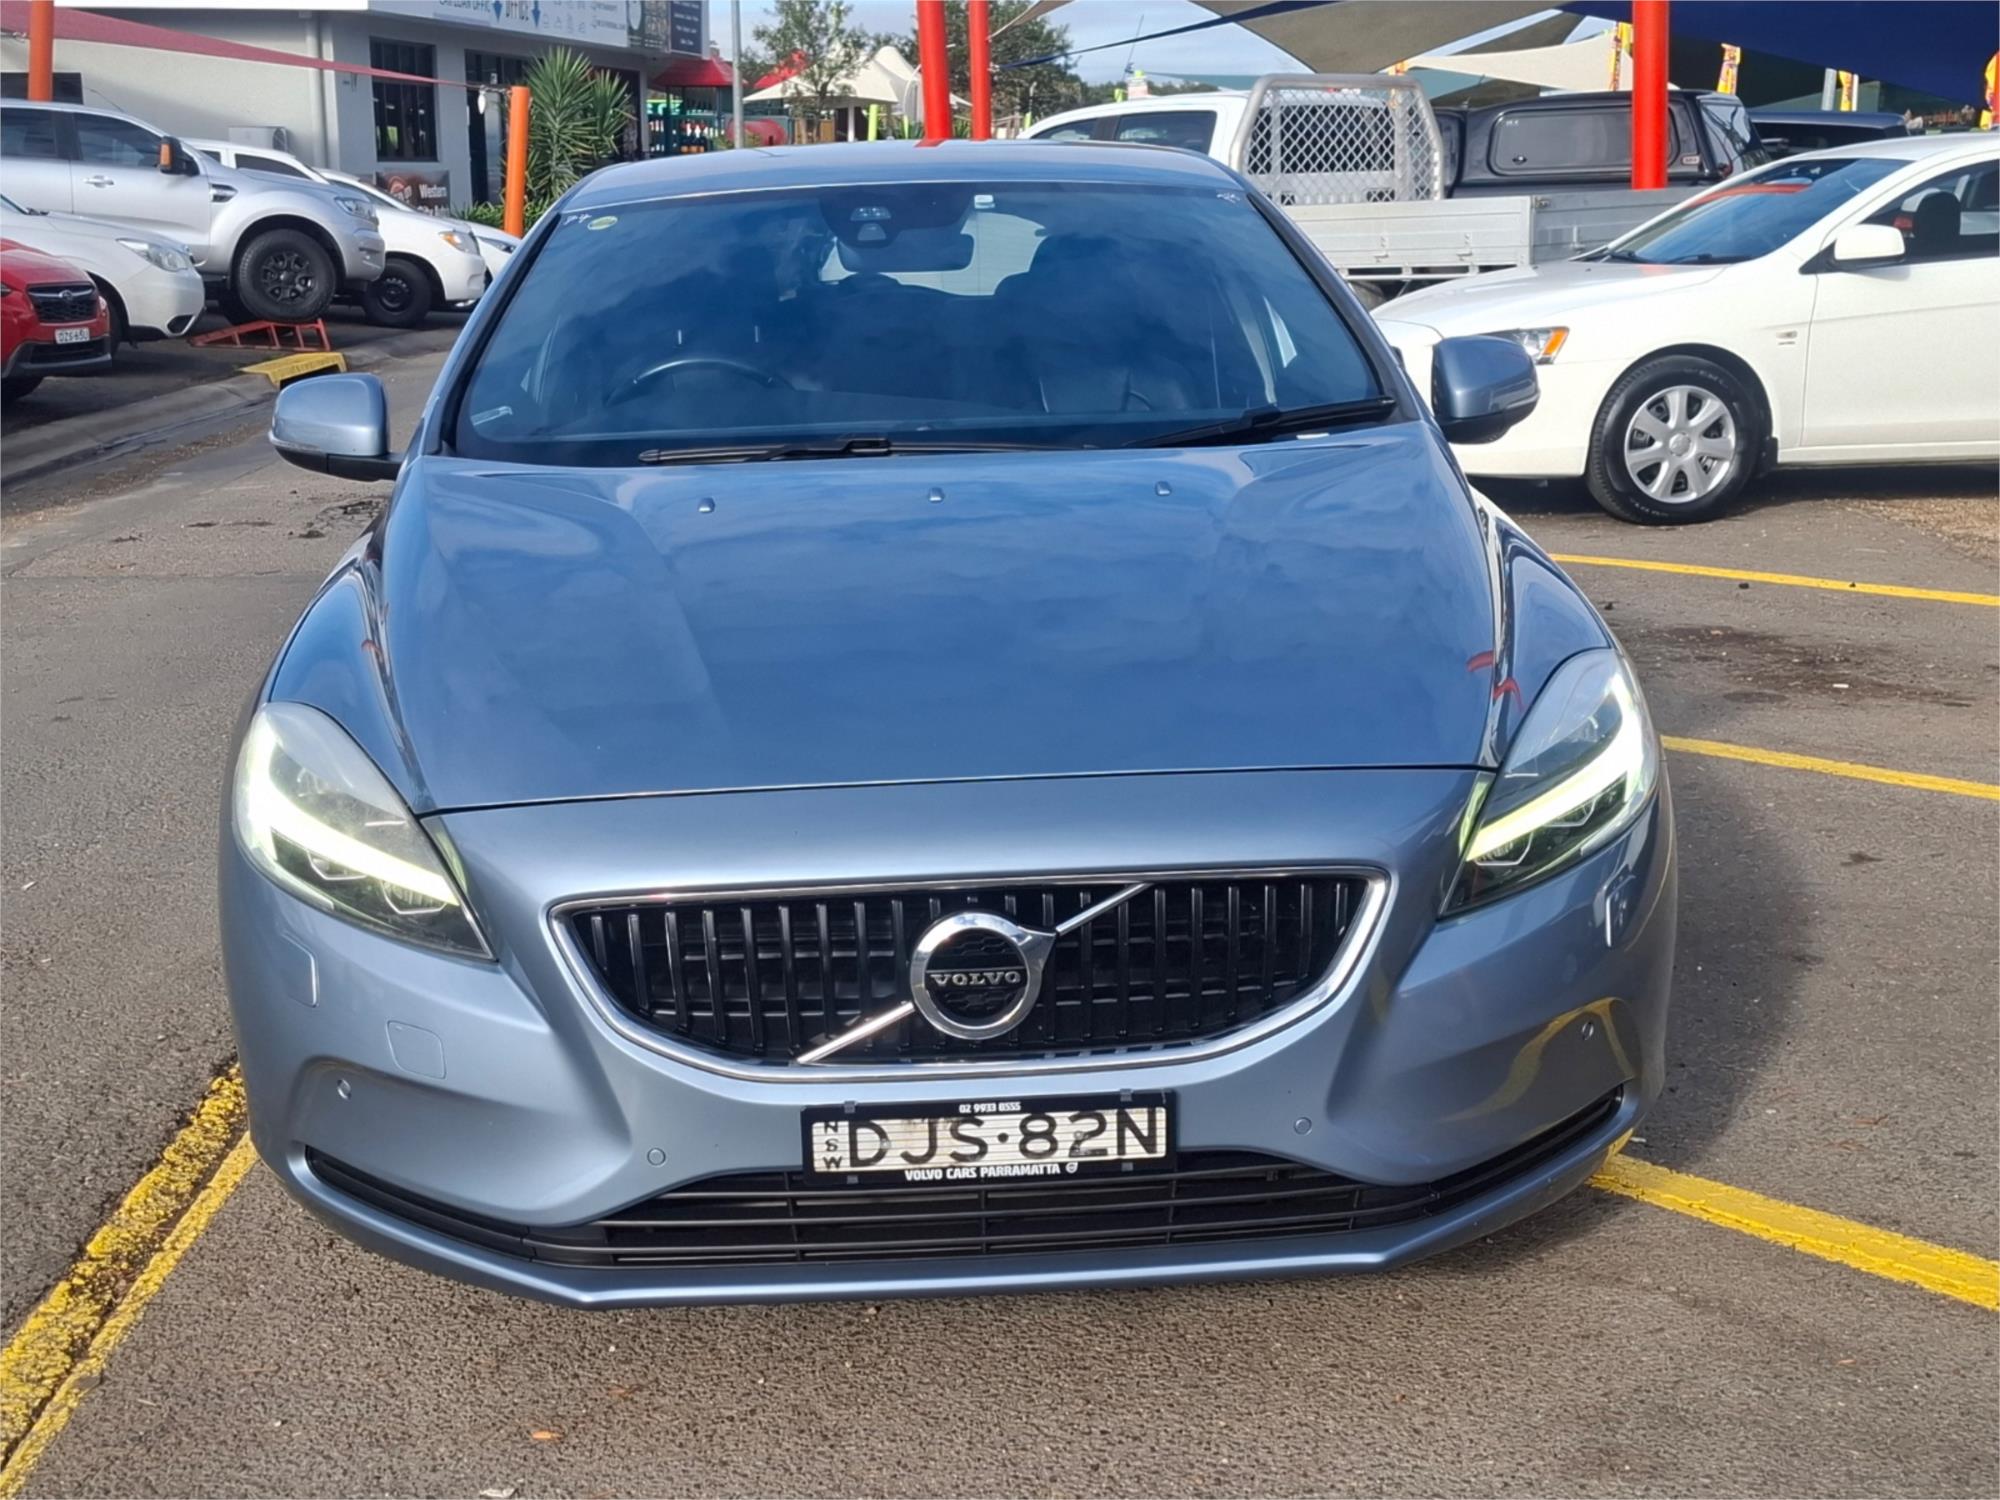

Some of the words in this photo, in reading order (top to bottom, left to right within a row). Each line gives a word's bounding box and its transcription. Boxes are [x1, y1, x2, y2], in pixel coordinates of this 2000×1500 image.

[930, 971, 1021, 986] VOLVO
[959, 1104, 972, 1114] 02
[973, 1102, 997, 1113] 9933
[822, 1120, 843, 1170] NSW
[904, 1168, 943, 1181] VOLVO
[945, 1166, 978, 1180] CARS
[980, 1163, 1061, 1178] PARRAMATTA
